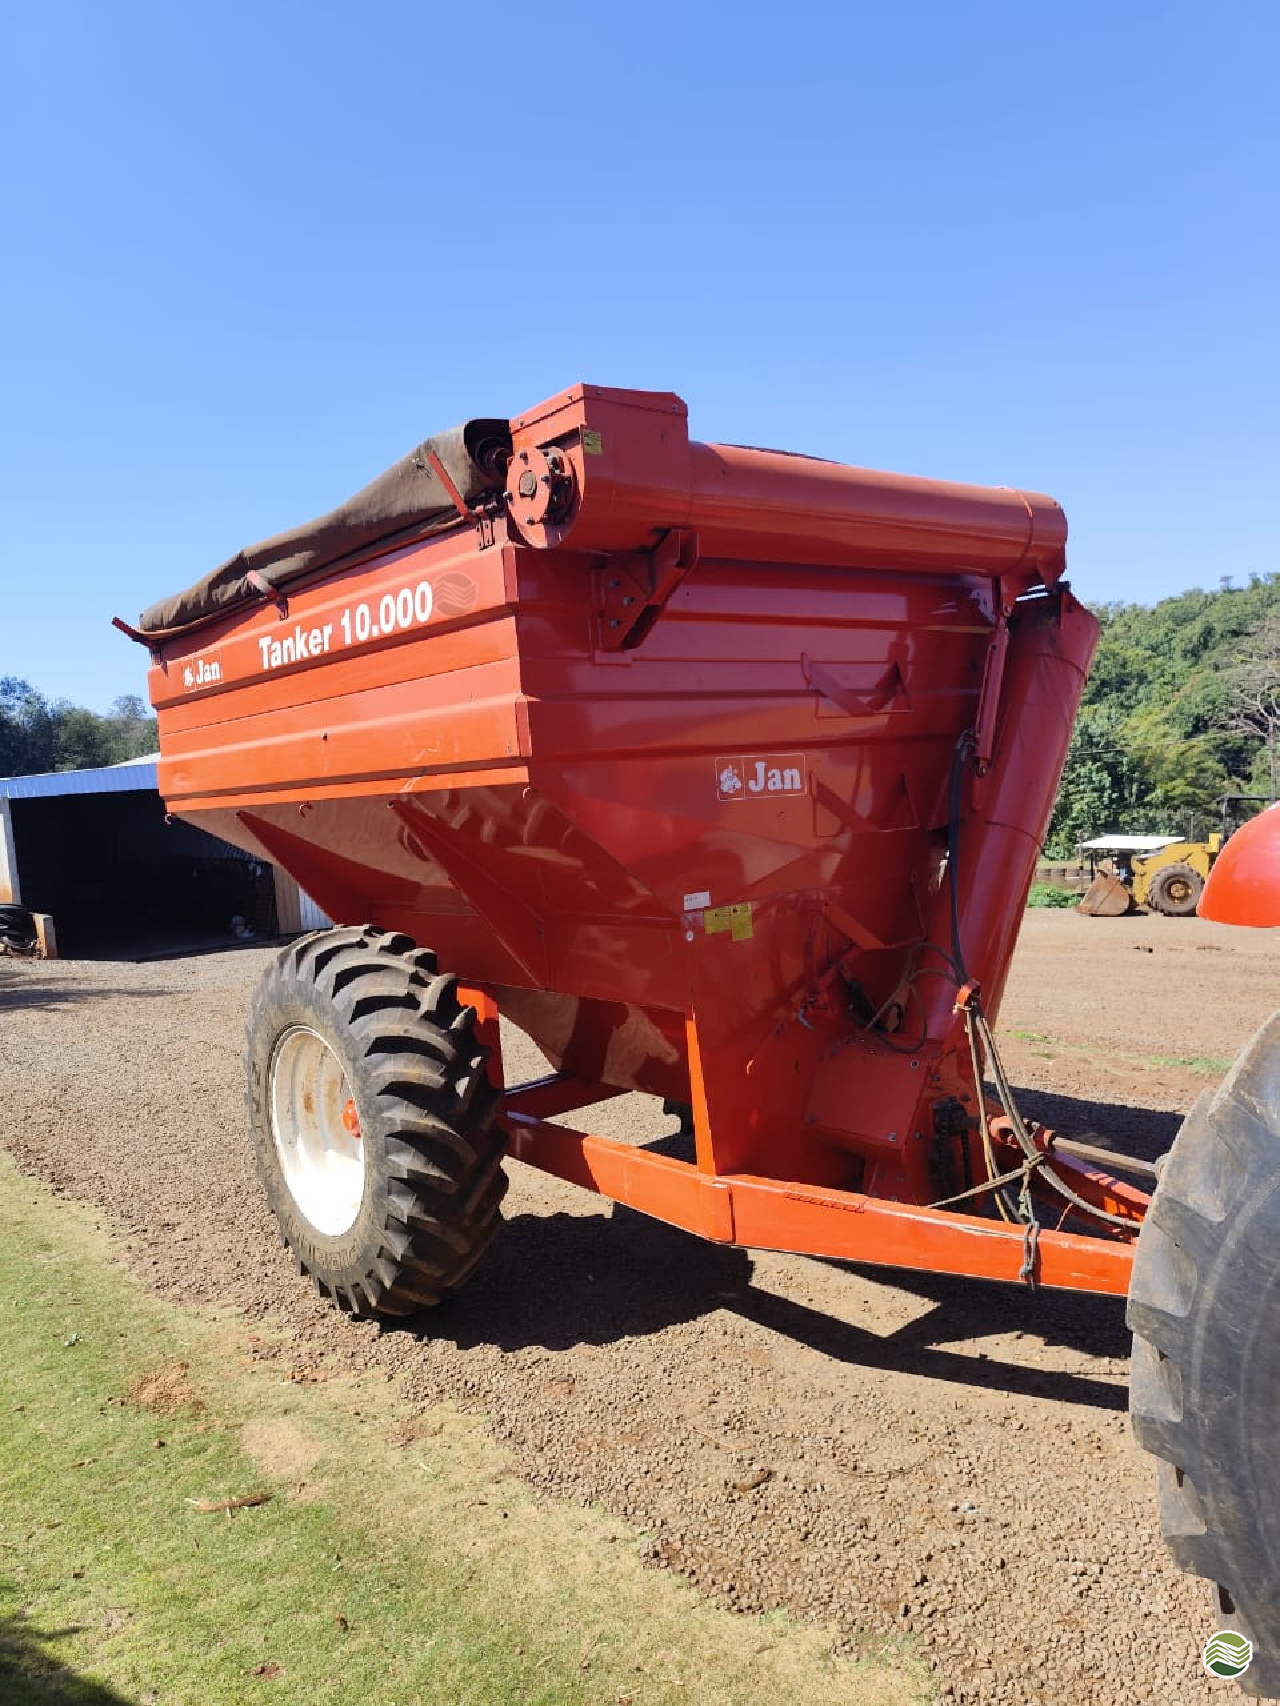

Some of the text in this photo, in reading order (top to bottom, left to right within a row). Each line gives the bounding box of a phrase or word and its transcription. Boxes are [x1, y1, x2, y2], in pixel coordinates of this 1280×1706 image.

[259, 581, 433, 670] Tanker 10.000
[196, 659, 221, 684] Jan
[749, 761, 801, 792] Jan
